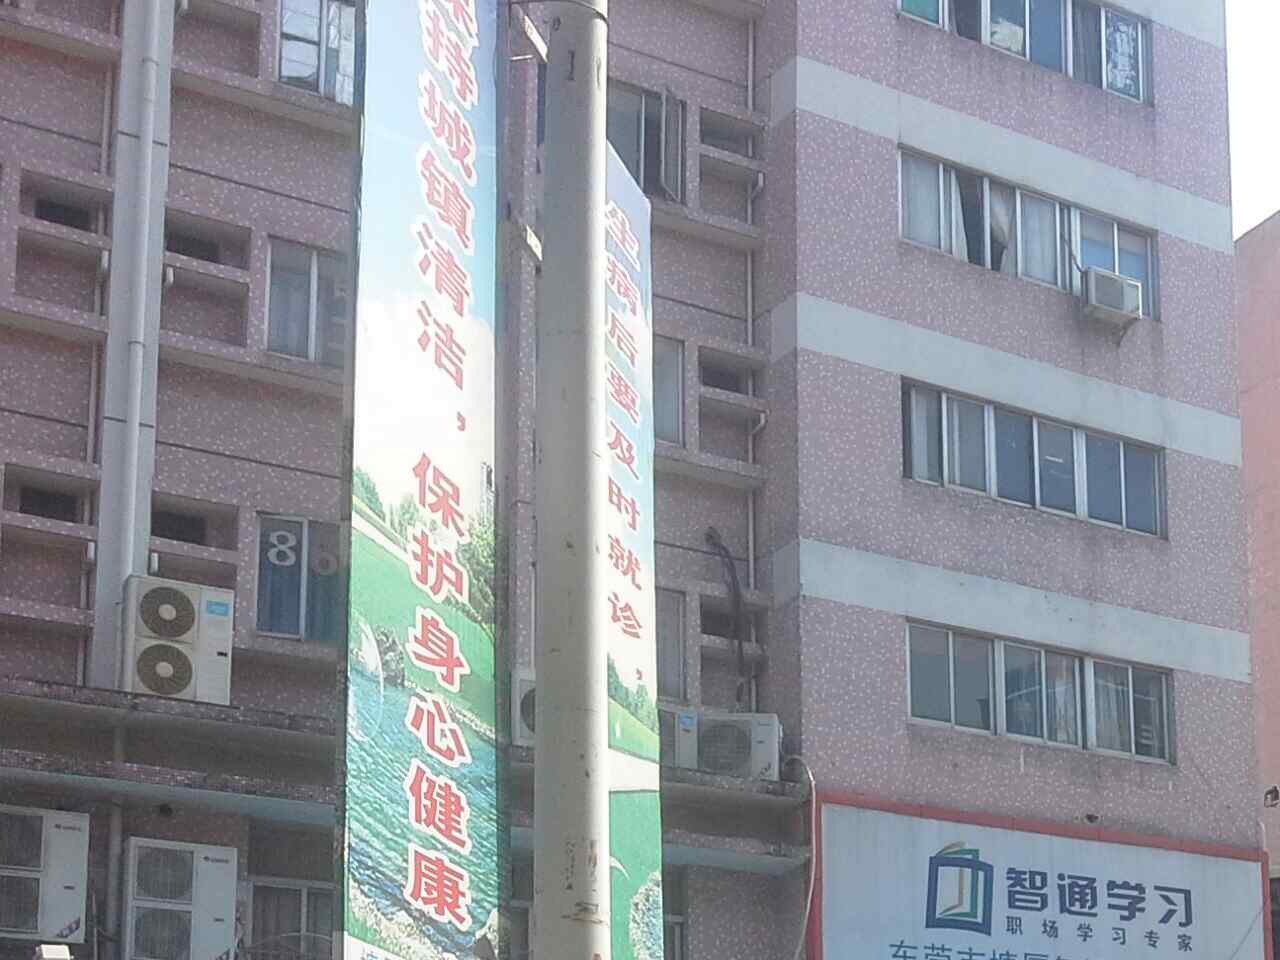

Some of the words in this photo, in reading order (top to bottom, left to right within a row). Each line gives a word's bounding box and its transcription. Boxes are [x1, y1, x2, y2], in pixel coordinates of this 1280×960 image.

[1006, 868, 1194, 928] 智通学习
[1006, 915, 1193, 953] 职场学习专家
